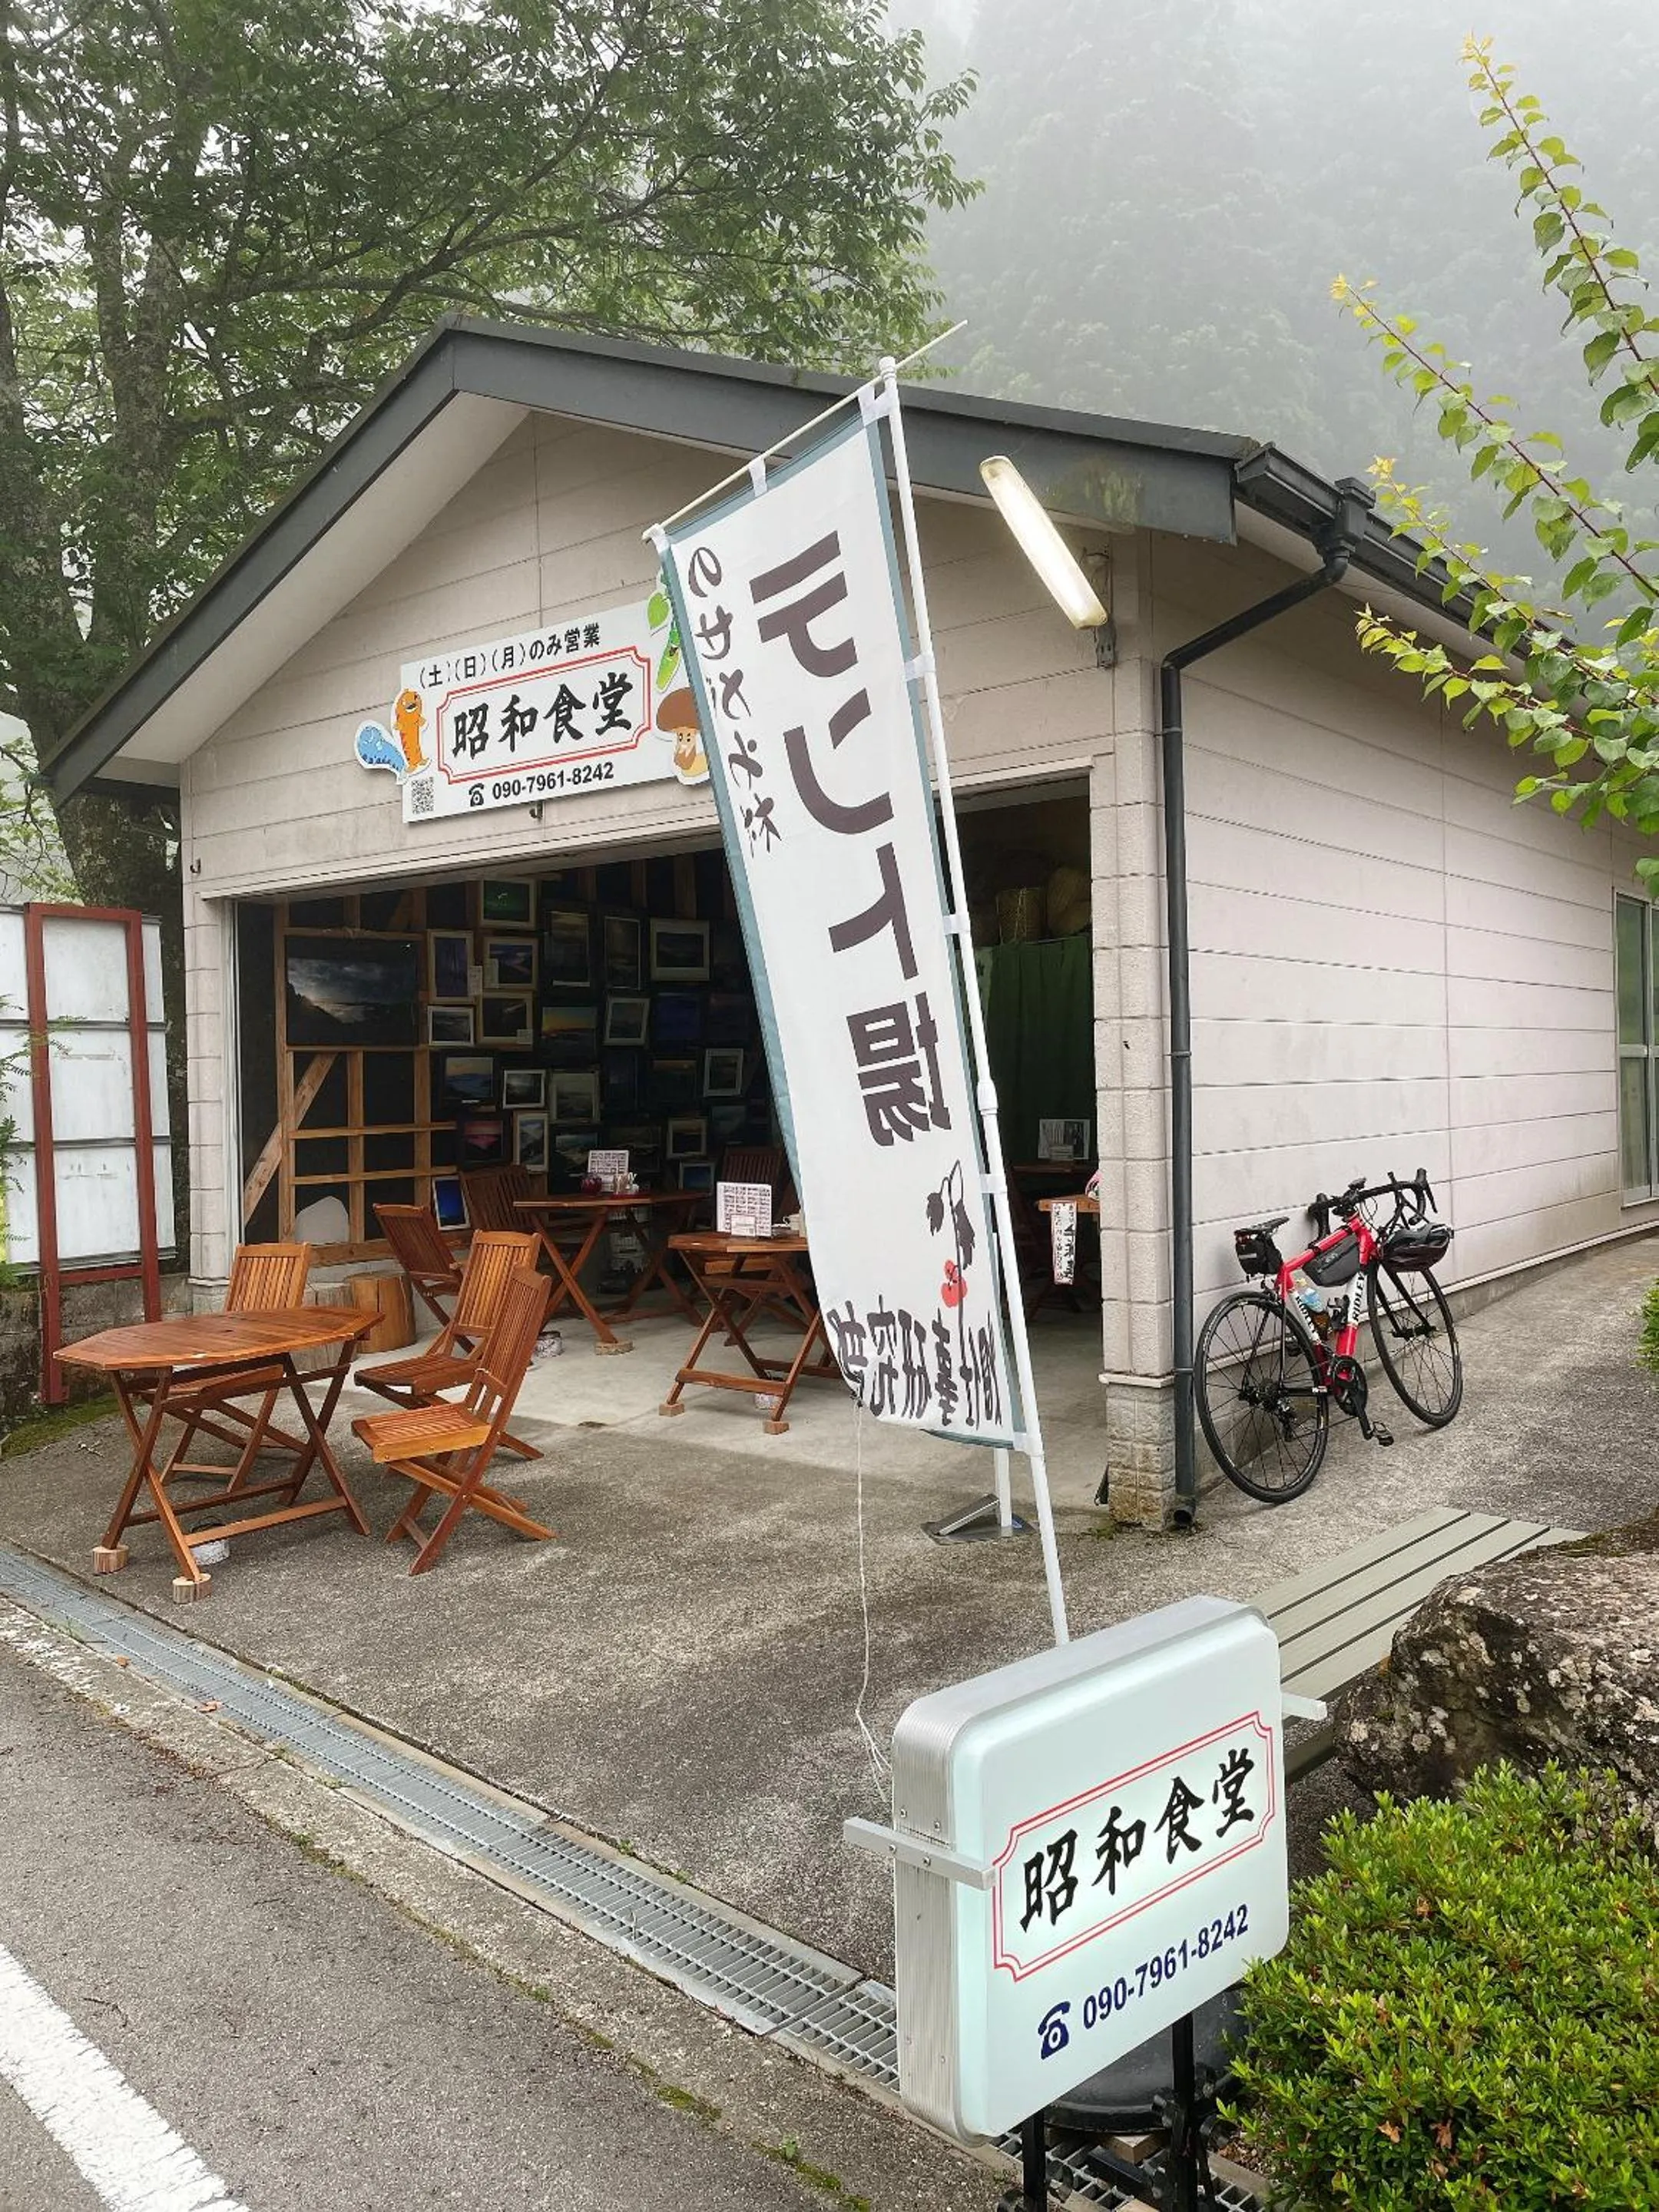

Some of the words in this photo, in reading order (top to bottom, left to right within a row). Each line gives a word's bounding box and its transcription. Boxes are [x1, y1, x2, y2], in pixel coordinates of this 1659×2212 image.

[452, 672, 634, 760] 昭和食堂
[492, 762, 614, 800] 090-7961-8242
[1020, 1748, 1254, 1932] 昭和食堂
[1083, 1904, 1249, 2030] 090-7961-8242
